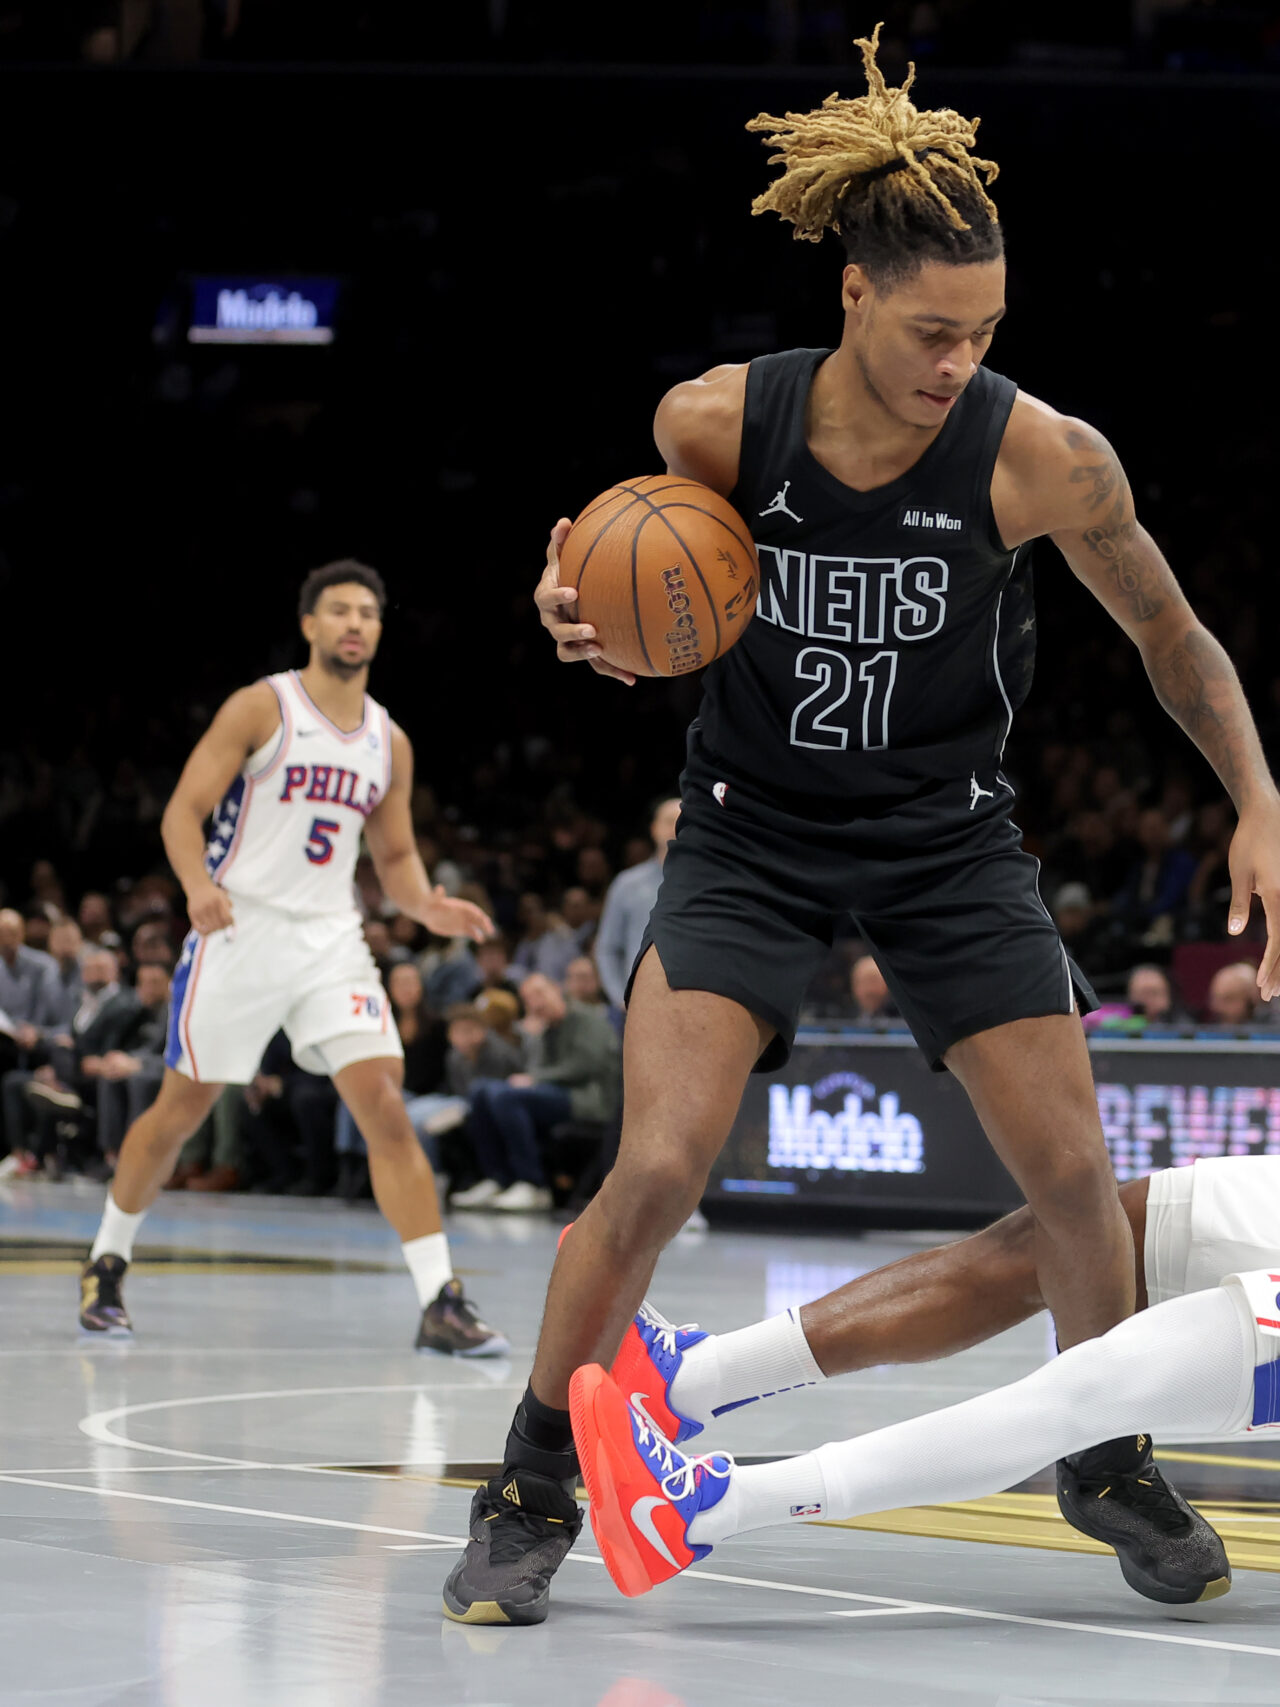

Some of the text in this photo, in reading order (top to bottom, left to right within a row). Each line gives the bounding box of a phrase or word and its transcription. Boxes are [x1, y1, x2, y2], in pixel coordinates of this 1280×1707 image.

[903, 510, 962, 531] All In Won
[755, 543, 949, 642] NETS
[790, 647, 899, 751] 21
[304, 816, 341, 866] 5
[351, 993, 380, 1018] 76
